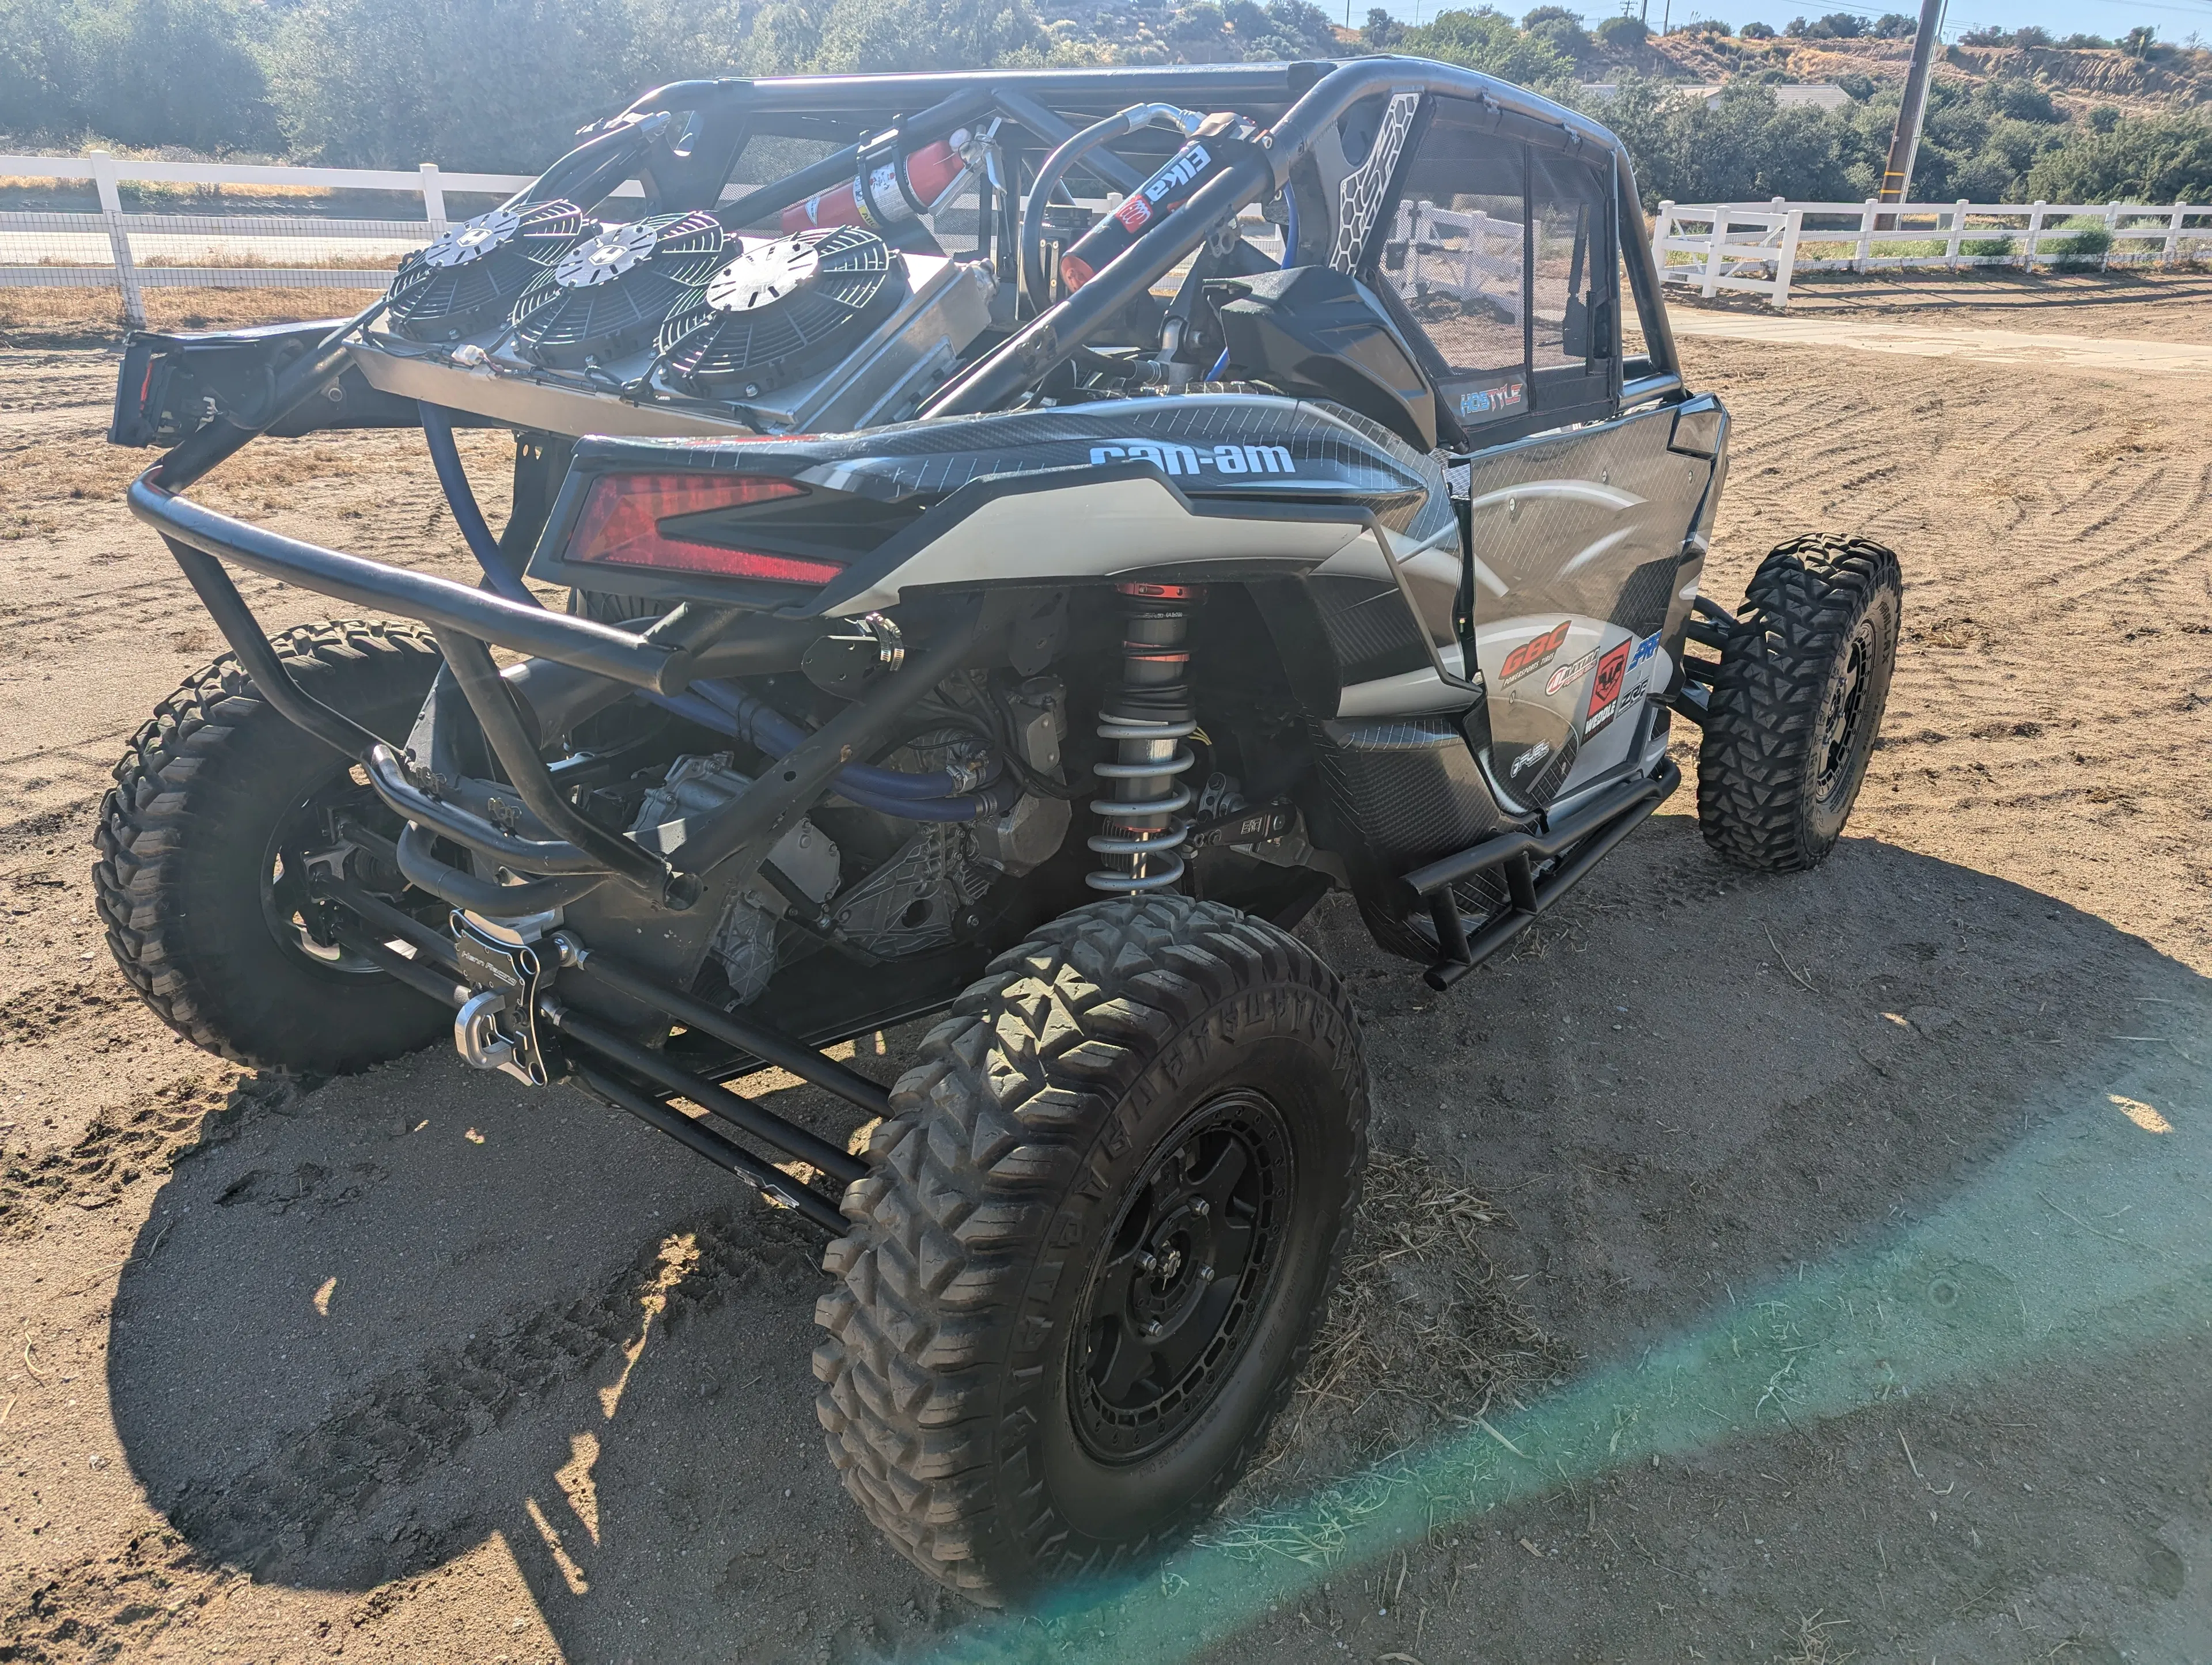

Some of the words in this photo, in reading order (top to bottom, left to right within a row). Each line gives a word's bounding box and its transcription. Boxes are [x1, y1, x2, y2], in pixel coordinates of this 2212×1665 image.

[1145, 145, 1211, 202] Elka
[1460, 384, 1522, 417] HOSTYLE
[1090, 445, 1296, 475] can-am
[1501, 623, 1571, 677] GBC
[1504, 661, 1539, 687] POWERSPORTS
[1540, 652, 1555, 665] TIRES
[1585, 699, 1617, 735] WEDDLE
[461, 950, 485, 967] Henn
[485, 962, 517, 987] Racing
